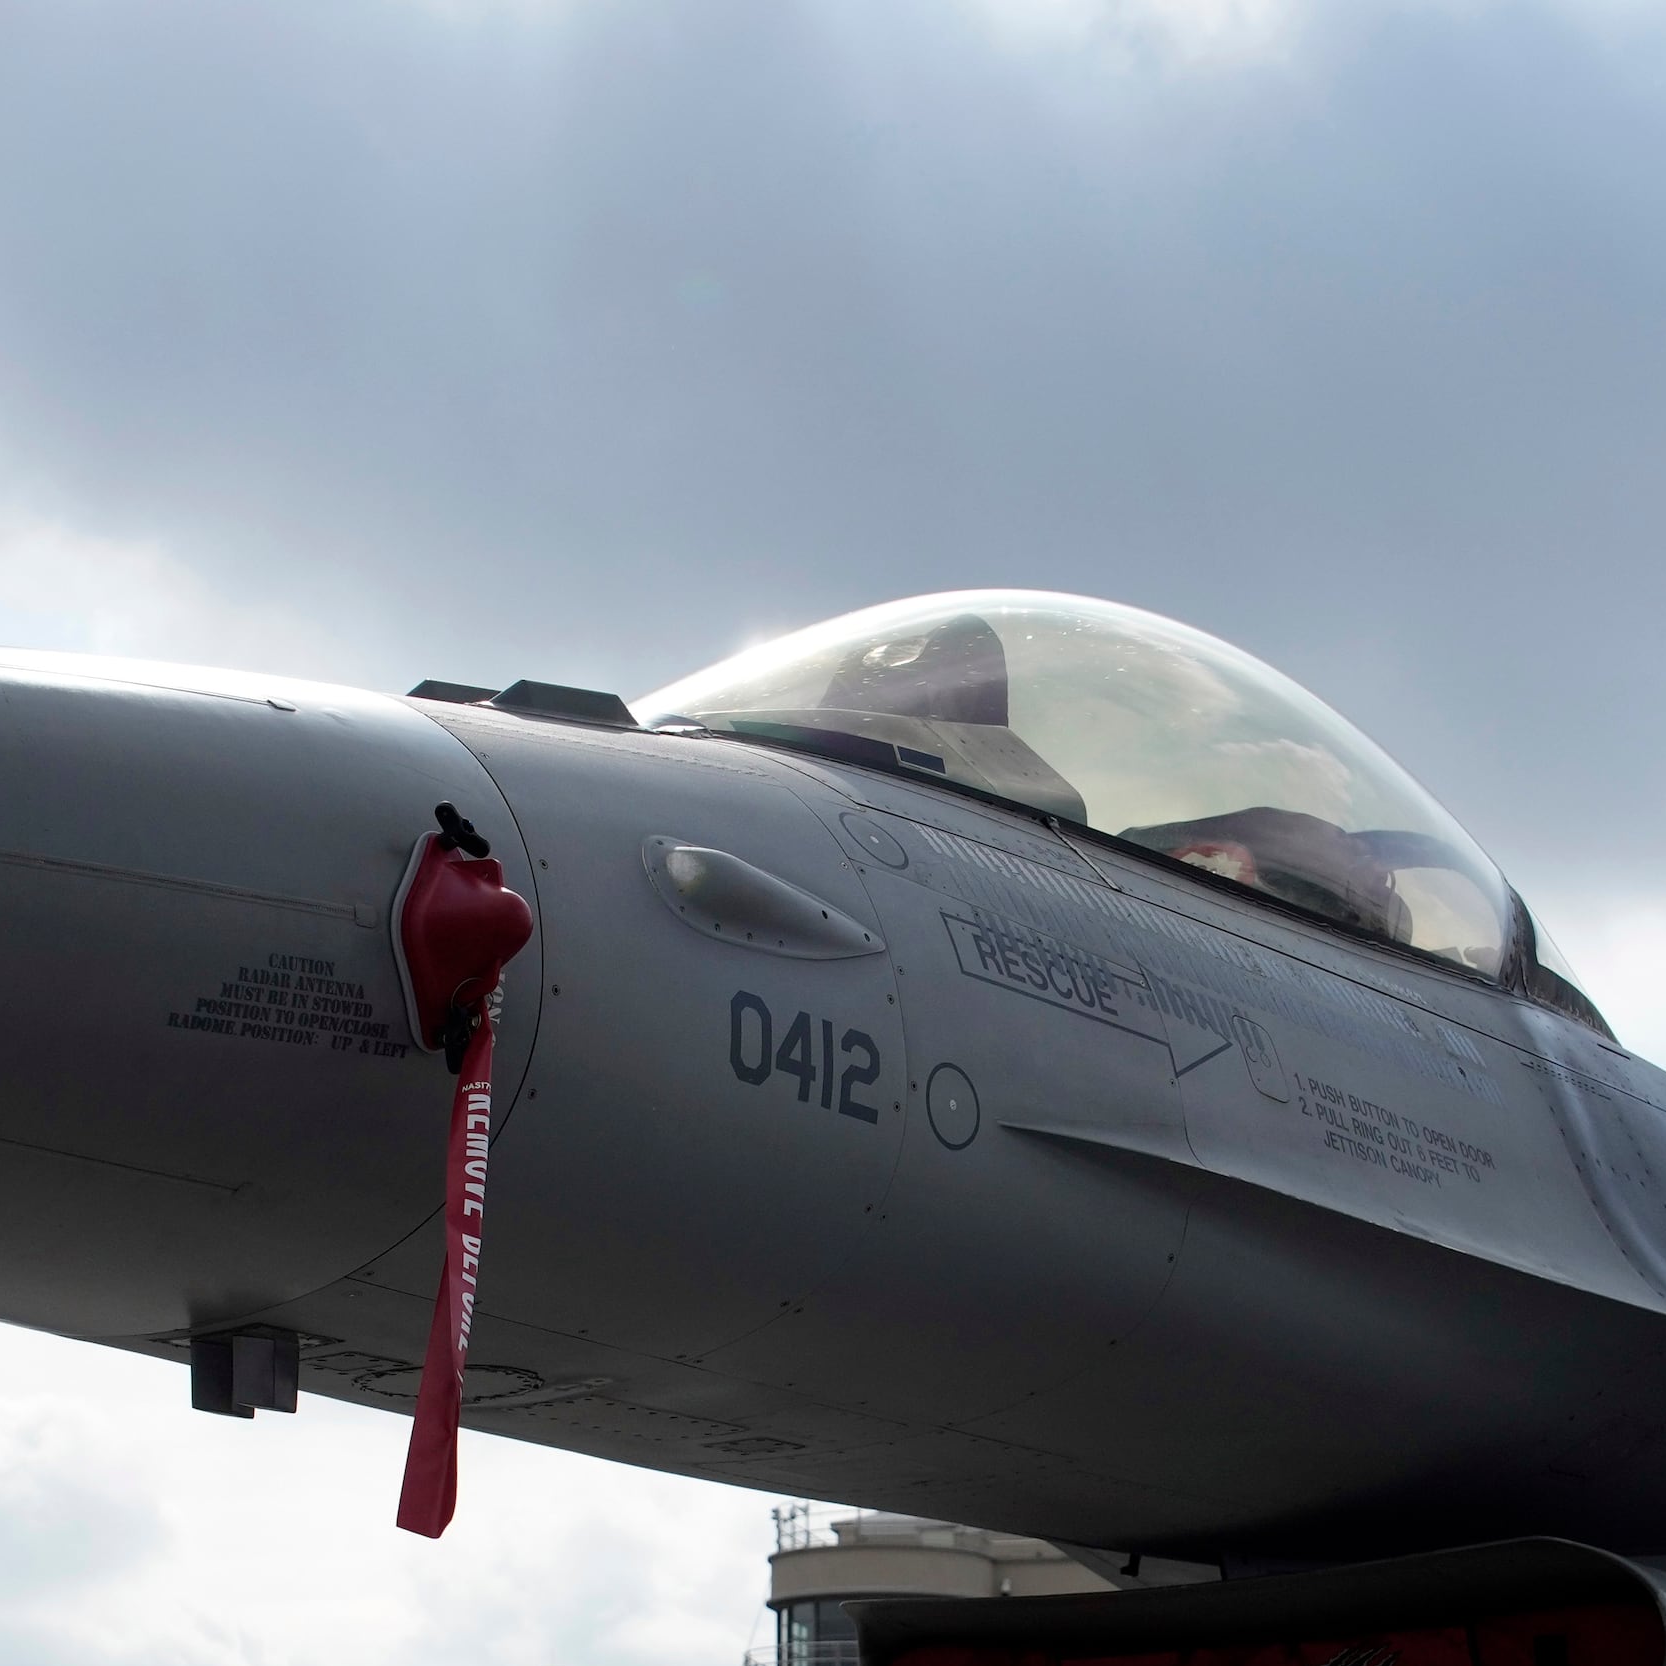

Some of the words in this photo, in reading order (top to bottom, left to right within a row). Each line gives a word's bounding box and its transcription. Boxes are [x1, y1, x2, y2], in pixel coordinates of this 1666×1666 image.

[239, 966, 290, 988] RADAR
[294, 975, 364, 999] ANTENNA
[269, 952, 334, 976] CAUTION
[972, 932, 1118, 1016] RESCUE
[195, 997, 271, 1021] POSITION
[275, 1009, 294, 1025] TO
[298, 1012, 389, 1039] OPEN/CLOSE
[220, 982, 263, 1002] MUST
[267, 990, 286, 1006] BE
[292, 993, 309, 1009] IN
[312, 997, 373, 1019] STOWED
[240, 1023, 319, 1045] POSITION:
[331, 1036, 352, 1051] UP
[359, 1040, 369, 1053] &
[373, 1041, 410, 1058] LEFT
[730, 990, 880, 1124] 0412
[1294, 1073, 1305, 1091] 1.
[1308, 1078, 1346, 1107] PUSH
[1347, 1095, 1400, 1130] BUTTON
[1401, 1117, 1419, 1138] TO
[1422, 1127, 1456, 1154] OPEN
[1458, 1141, 1497, 1170] DOOR
[1298, 1097, 1312, 1116] 2.
[1315, 1103, 1349, 1131] PULL
[1352, 1117, 1384, 1145] RING
[1387, 1133, 1413, 1157] OUT
[1428, 1150, 1459, 1175] FEET
[1462, 1163, 1480, 1183] TO
[1323, 1130, 1387, 1168] JETTISON
[1390, 1155, 1441, 1188] CANOPY
